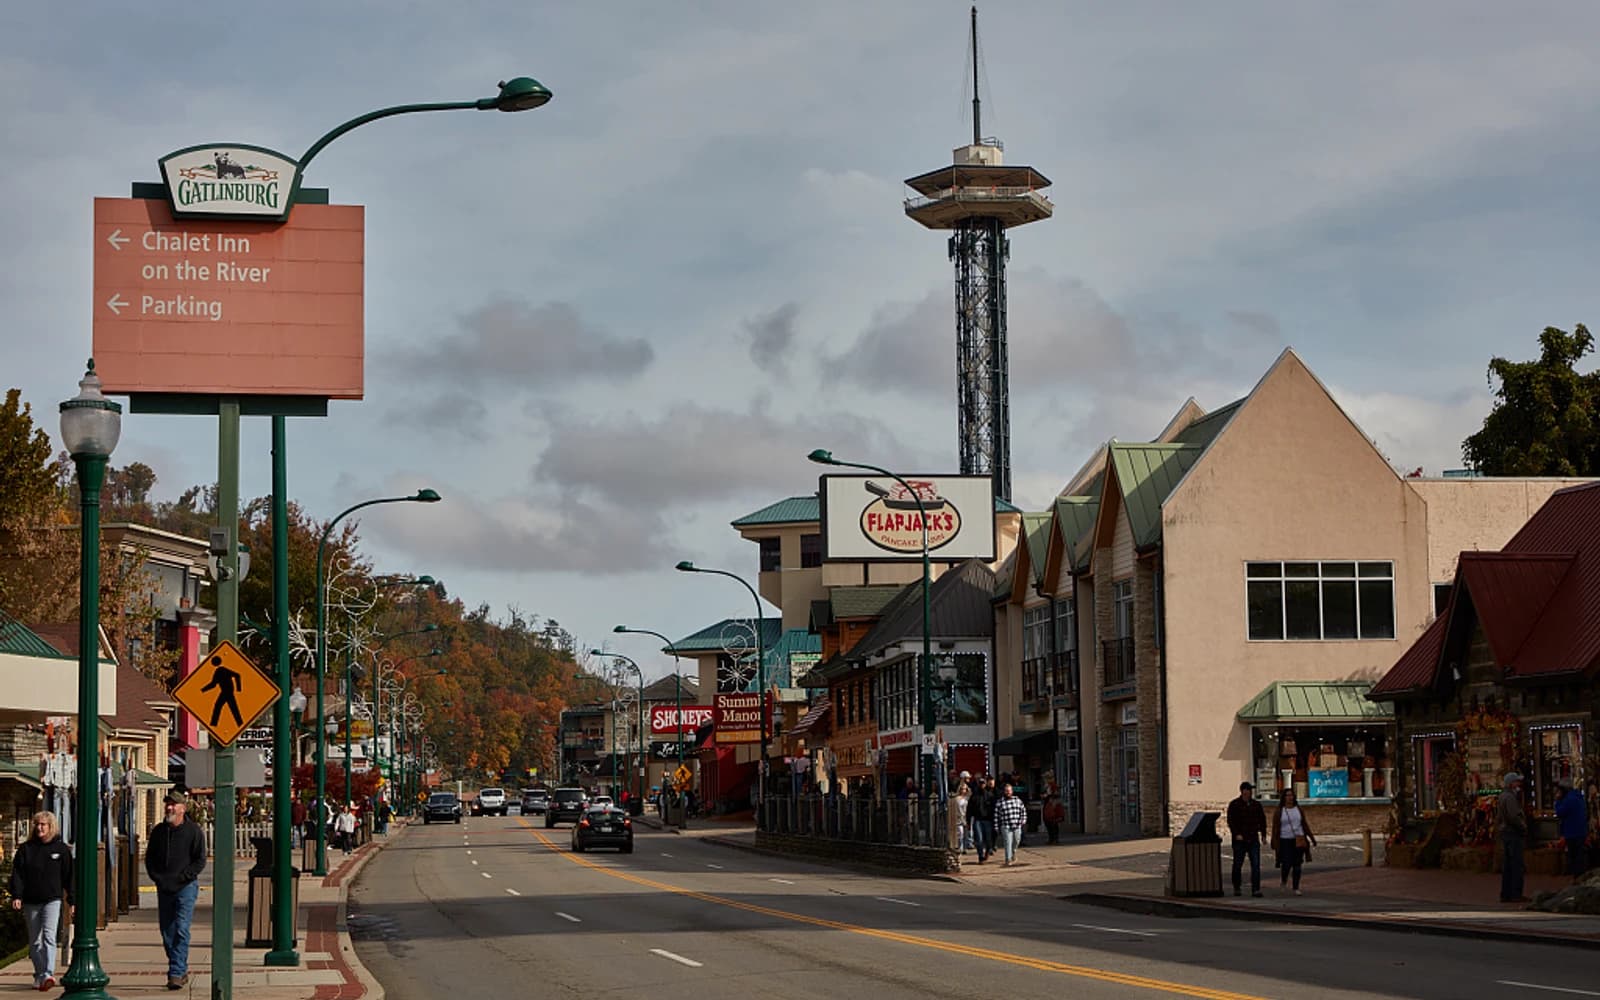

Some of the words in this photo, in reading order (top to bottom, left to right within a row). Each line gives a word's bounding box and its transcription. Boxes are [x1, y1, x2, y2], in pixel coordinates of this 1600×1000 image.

[178, 180, 279, 208] GATLINBURG
[142, 231, 210, 252] Chalet
[217, 233, 250, 253] Inn
[142, 264, 169, 280] on
[175, 260, 210, 281] the
[216, 262, 270, 282] River
[141, 295, 222, 320] Parking
[867, 511, 953, 532] FLAPJACK'S
[652, 709, 713, 730] SHONEY'S
